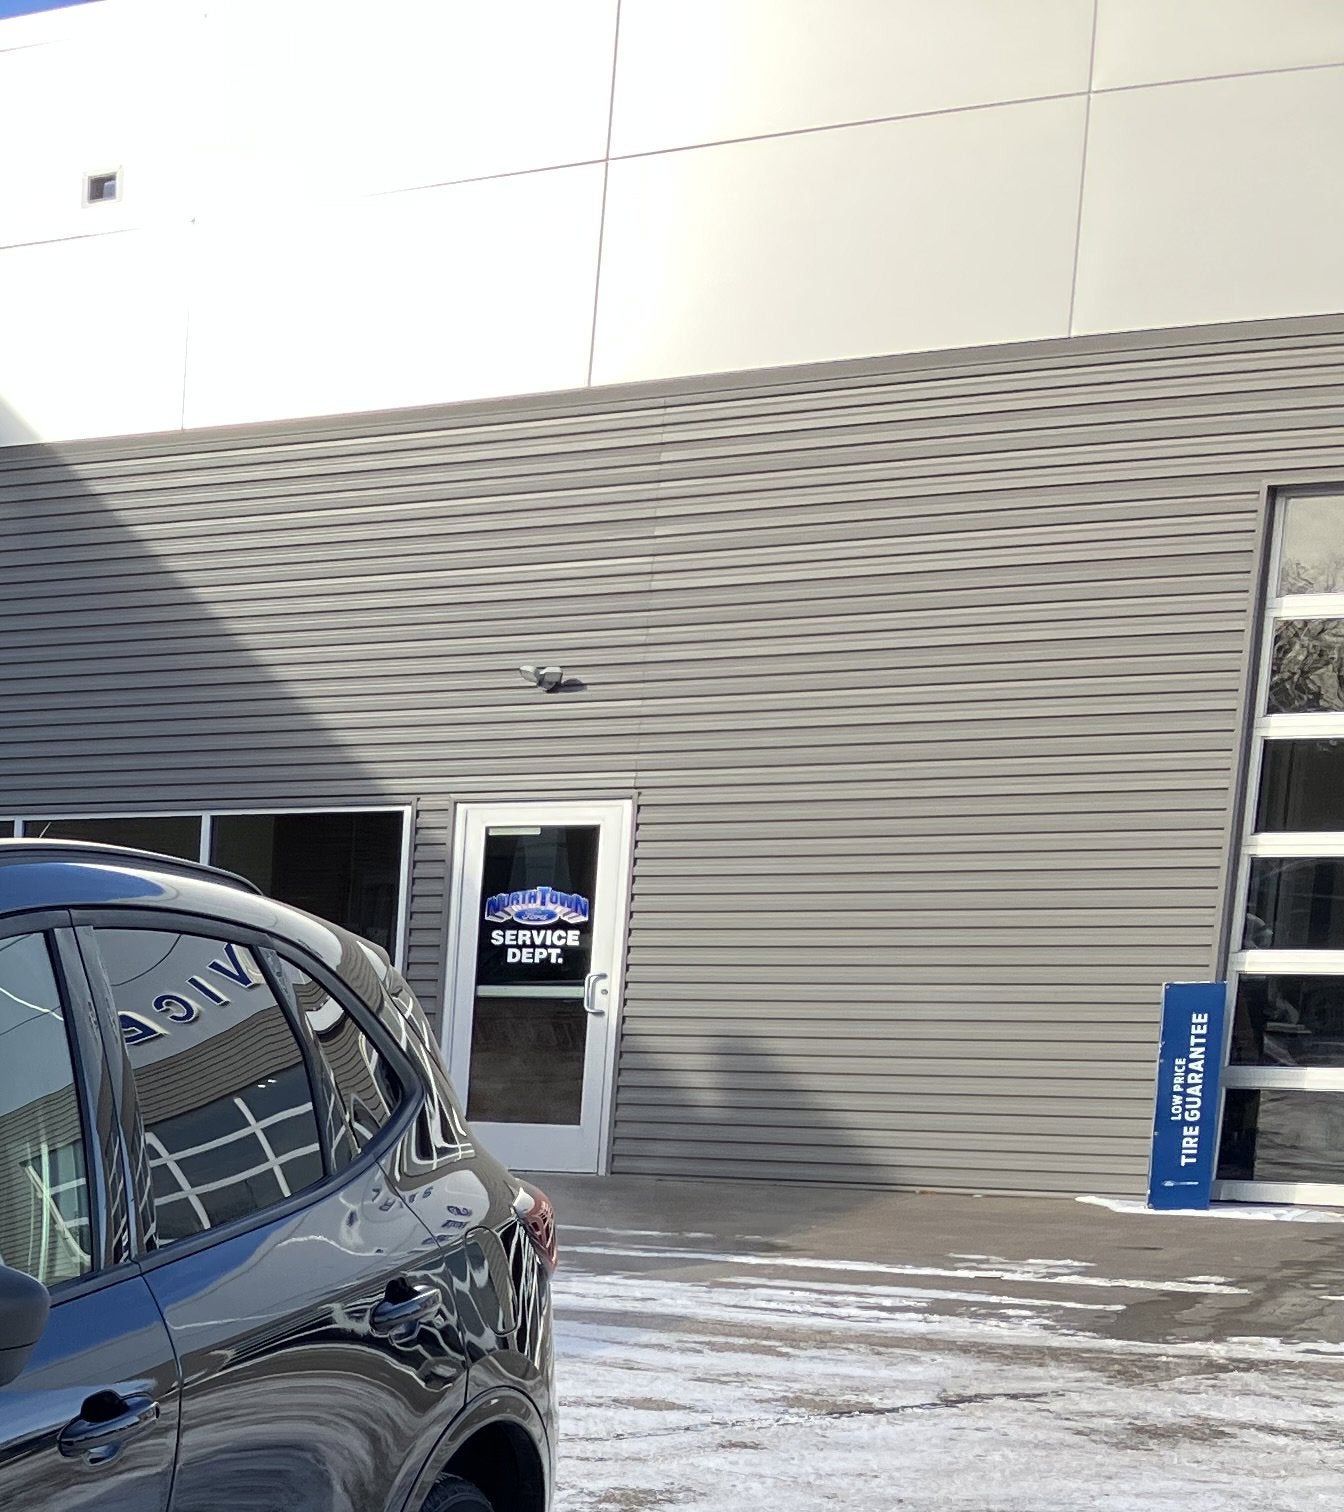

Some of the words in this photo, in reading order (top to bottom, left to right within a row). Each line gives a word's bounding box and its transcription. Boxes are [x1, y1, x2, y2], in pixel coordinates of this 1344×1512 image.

[491, 929, 580, 946] SERVICE
[507, 948, 563, 963] DEPT.
[1173, 1057, 1186, 1092] PRICE
[1185, 1012, 1209, 1122] GUARANTEE
[1171, 1094, 1182, 1121] LOW
[1181, 1125, 1200, 1167] TIRE
